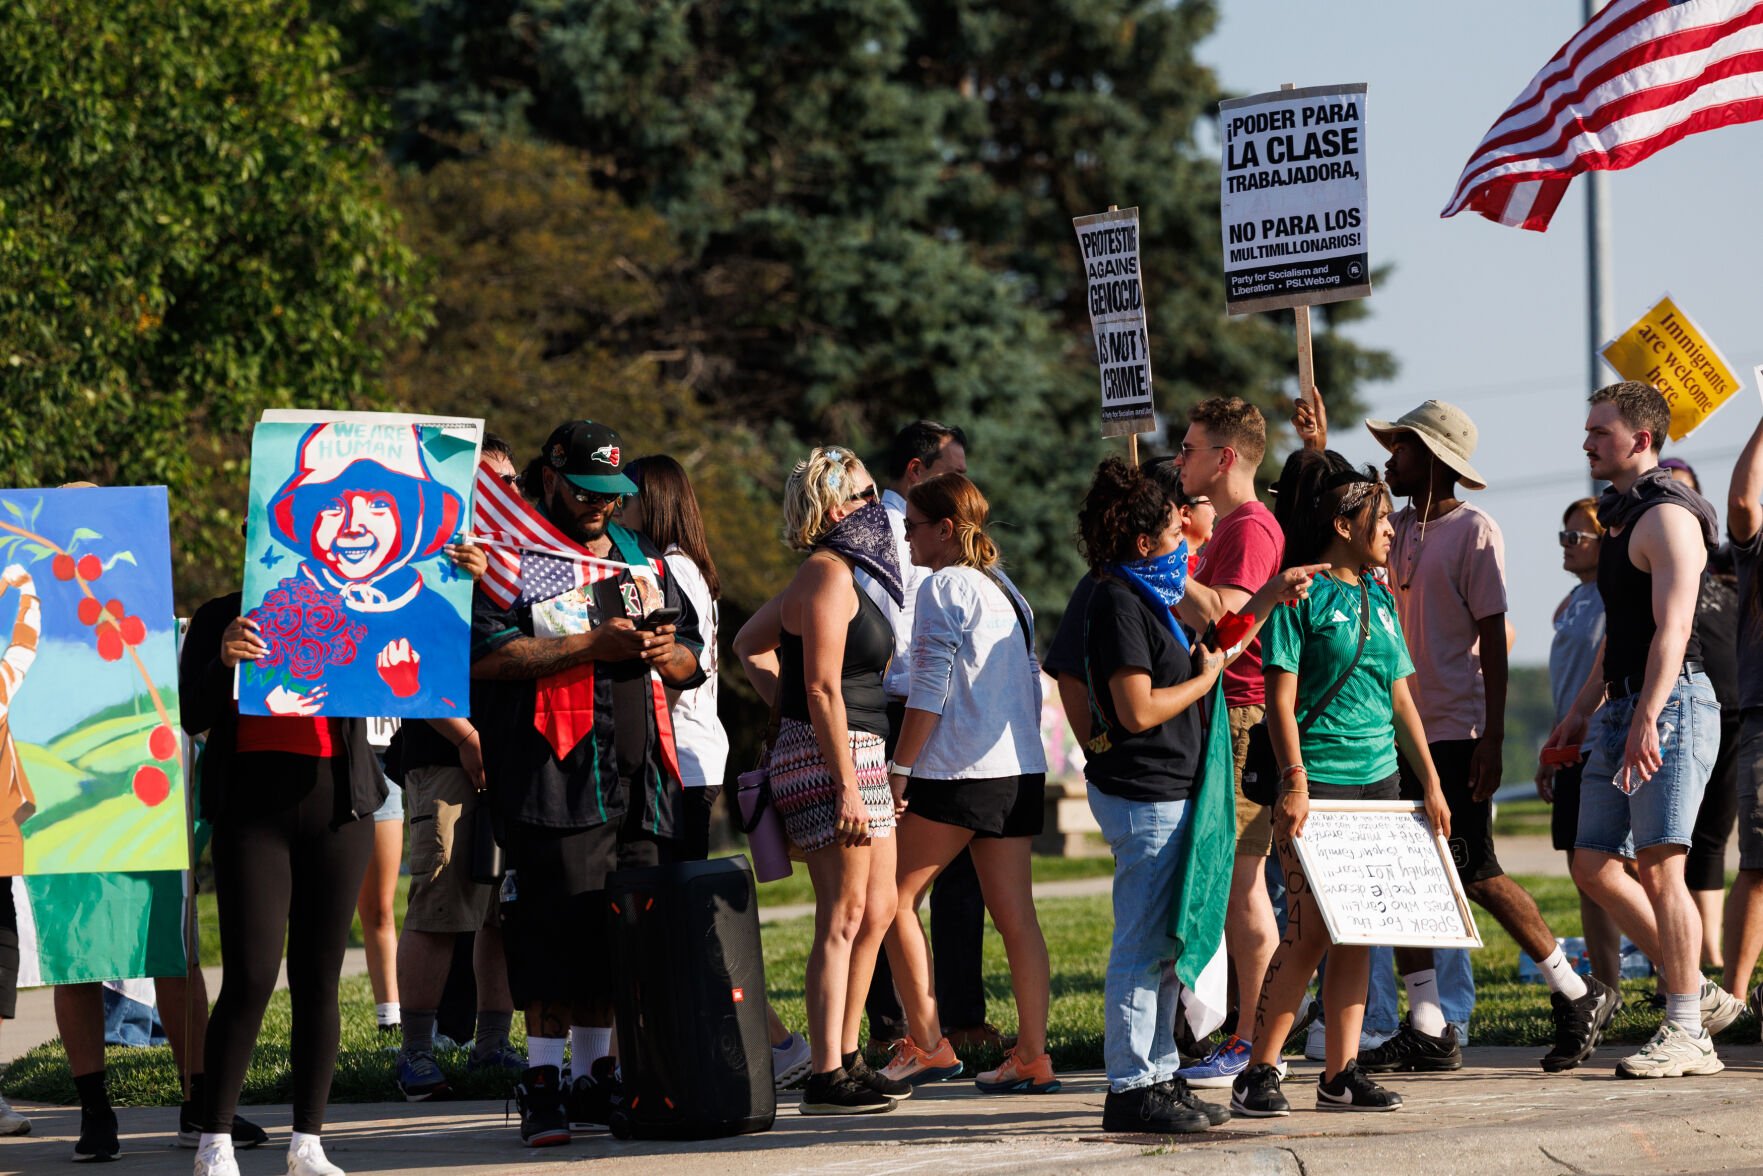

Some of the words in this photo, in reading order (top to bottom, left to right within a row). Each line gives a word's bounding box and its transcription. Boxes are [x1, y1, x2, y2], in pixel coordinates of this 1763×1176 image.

[1227, 109, 1295, 142] ¡PODER
[1302, 102, 1359, 127] PARA
[1228, 142, 1259, 171] LA
[1267, 127, 1358, 164] CLASE
[1227, 161, 1359, 193] TRABAJADORA,
[1230, 222, 1255, 244] NO
[1262, 214, 1319, 239] PARA
[1325, 208, 1361, 232] LOS
[1230, 233, 1361, 262] MULTIMILLONARIOS!
[1089, 257, 1136, 280] AGAINS
[1232, 275, 1253, 285] Party
[1255, 272, 1266, 282] for
[1268, 267, 1311, 280] Socialism
[1313, 265, 1329, 274] and
[1233, 283, 1274, 295] Liberation
[1286, 276, 1340, 288] PSLWeb.org
[1090, 279, 1141, 316] GENOCID
[1099, 333, 1108, 364] IS
[1109, 330, 1137, 363] NOT
[1660, 312, 1728, 395] Immigrants
[1104, 364, 1149, 400] CRIME!
[1638, 325, 1666, 354] are
[1665, 352, 1713, 413] welcome
[319, 439, 404, 459] HUMAN
[333, 424, 365, 438] WE
[370, 425, 407, 441] ARE
